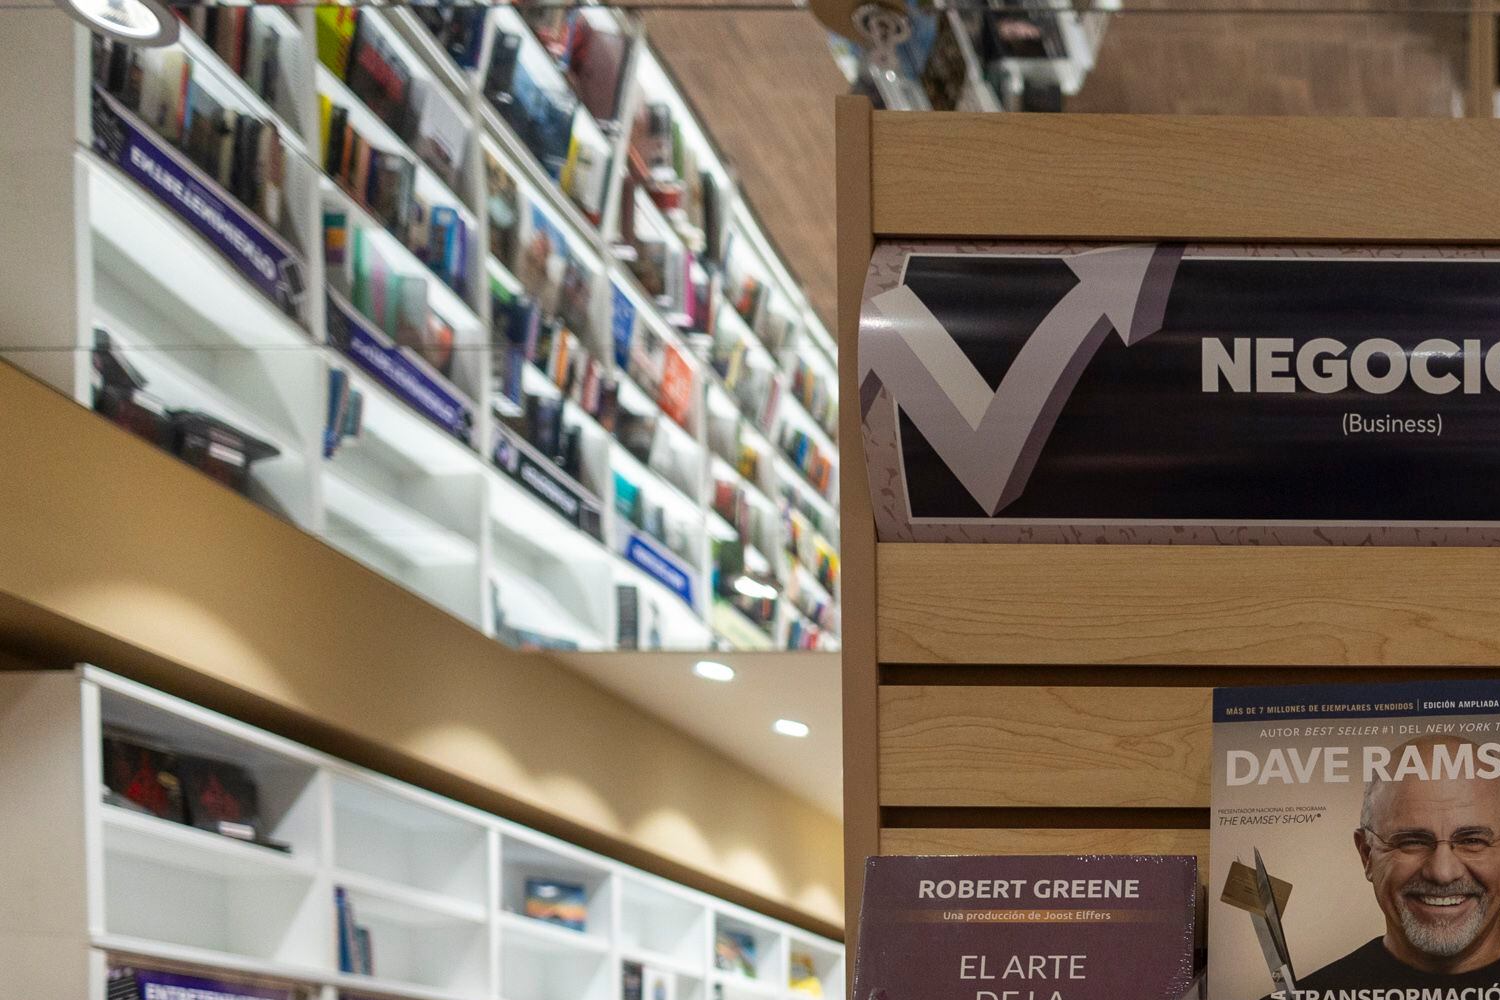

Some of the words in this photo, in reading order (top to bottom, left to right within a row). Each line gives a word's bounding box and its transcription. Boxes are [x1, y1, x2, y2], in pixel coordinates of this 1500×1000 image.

[1341, 413, 1443, 435] (Business)
[1246, 706, 1256, 715] DE
[1259, 706, 1263, 714] 7
[1267, 705, 1306, 714] MILLONES
[1308, 704, 1318, 712] DE
[1321, 703, 1371, 712] EJEMPLARES
[1374, 702, 1414, 711] VENDIDOS
[1423, 700, 1455, 709] EDICIÓN
[1458, 699, 1499, 708] AMPLIADA
[1260, 728, 1300, 738] AUTOR
[1305, 726, 1334, 737] BEST
[1337, 726, 1379, 736] SELLER
[1382, 725, 1394, 735] #1
[1400, 725, 1421, 734] DEL
[1425, 723, 1454, 733] NEW
[1459, 722, 1491, 732] YORK
[1226, 746, 1350, 787] DAVE
[1219, 816, 1238, 826] THE
[1240, 815, 1281, 825] RAMSEY
[918, 879, 1027, 899] ROBERT
[1033, 879, 1140, 898] GREENE
[943, 911, 964, 920] Una
[966, 909, 1026, 922] producción
[1028, 910, 1042, 920] de
[1044, 910, 1073, 920] Joost
[1076, 910, 1111, 920] Elffers
[959, 955, 995, 979] EL
[1002, 955, 1087, 979] ARTE
